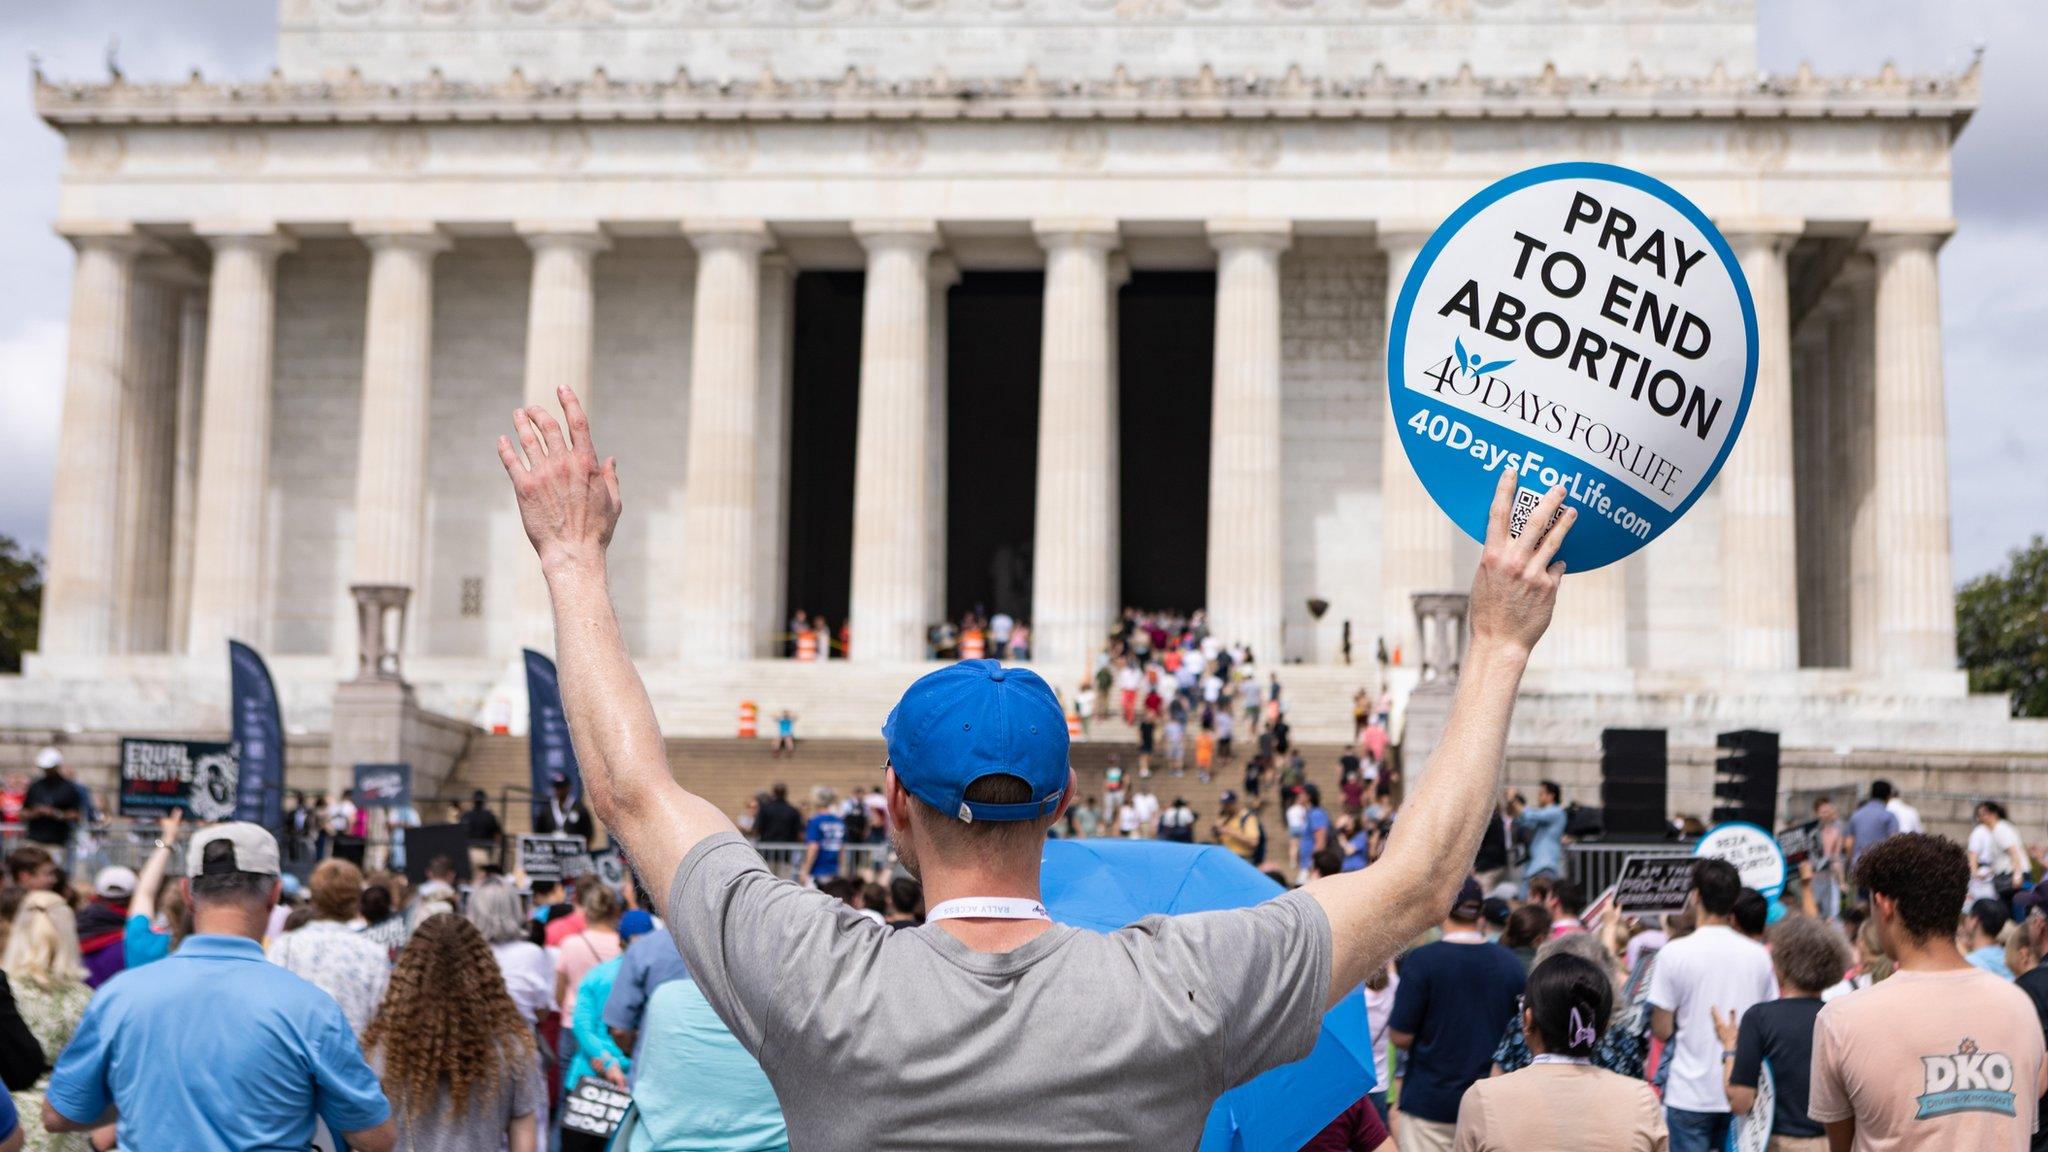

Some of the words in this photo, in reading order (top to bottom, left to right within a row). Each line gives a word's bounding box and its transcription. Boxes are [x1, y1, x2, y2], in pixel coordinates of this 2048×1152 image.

[1563, 191, 1706, 287] PRAY
[1513, 231, 1586, 298] TO
[1600, 275, 1711, 360] END
[1438, 279, 1723, 440] ABORTION
[1423, 354, 1480, 396] 40
[1482, 375, 1567, 433] DAYS
[1567, 412, 1630, 471] FOR
[1626, 444, 1683, 496] LIFE
[1408, 409, 1652, 540] 40DaysForLife.com
[124, 741, 189, 764] EQUAL
[1621, 877, 1693, 893] PRO-LIFE
[1639, 865, 1663, 877] AM
[1667, 865, 1693, 878] THE
[944, 905, 977, 914] ACCESS
[981, 906, 1010, 914] RALLY
[1617, 892, 1686, 905] GENERATION
[1920, 1052, 2013, 1096] DKO
